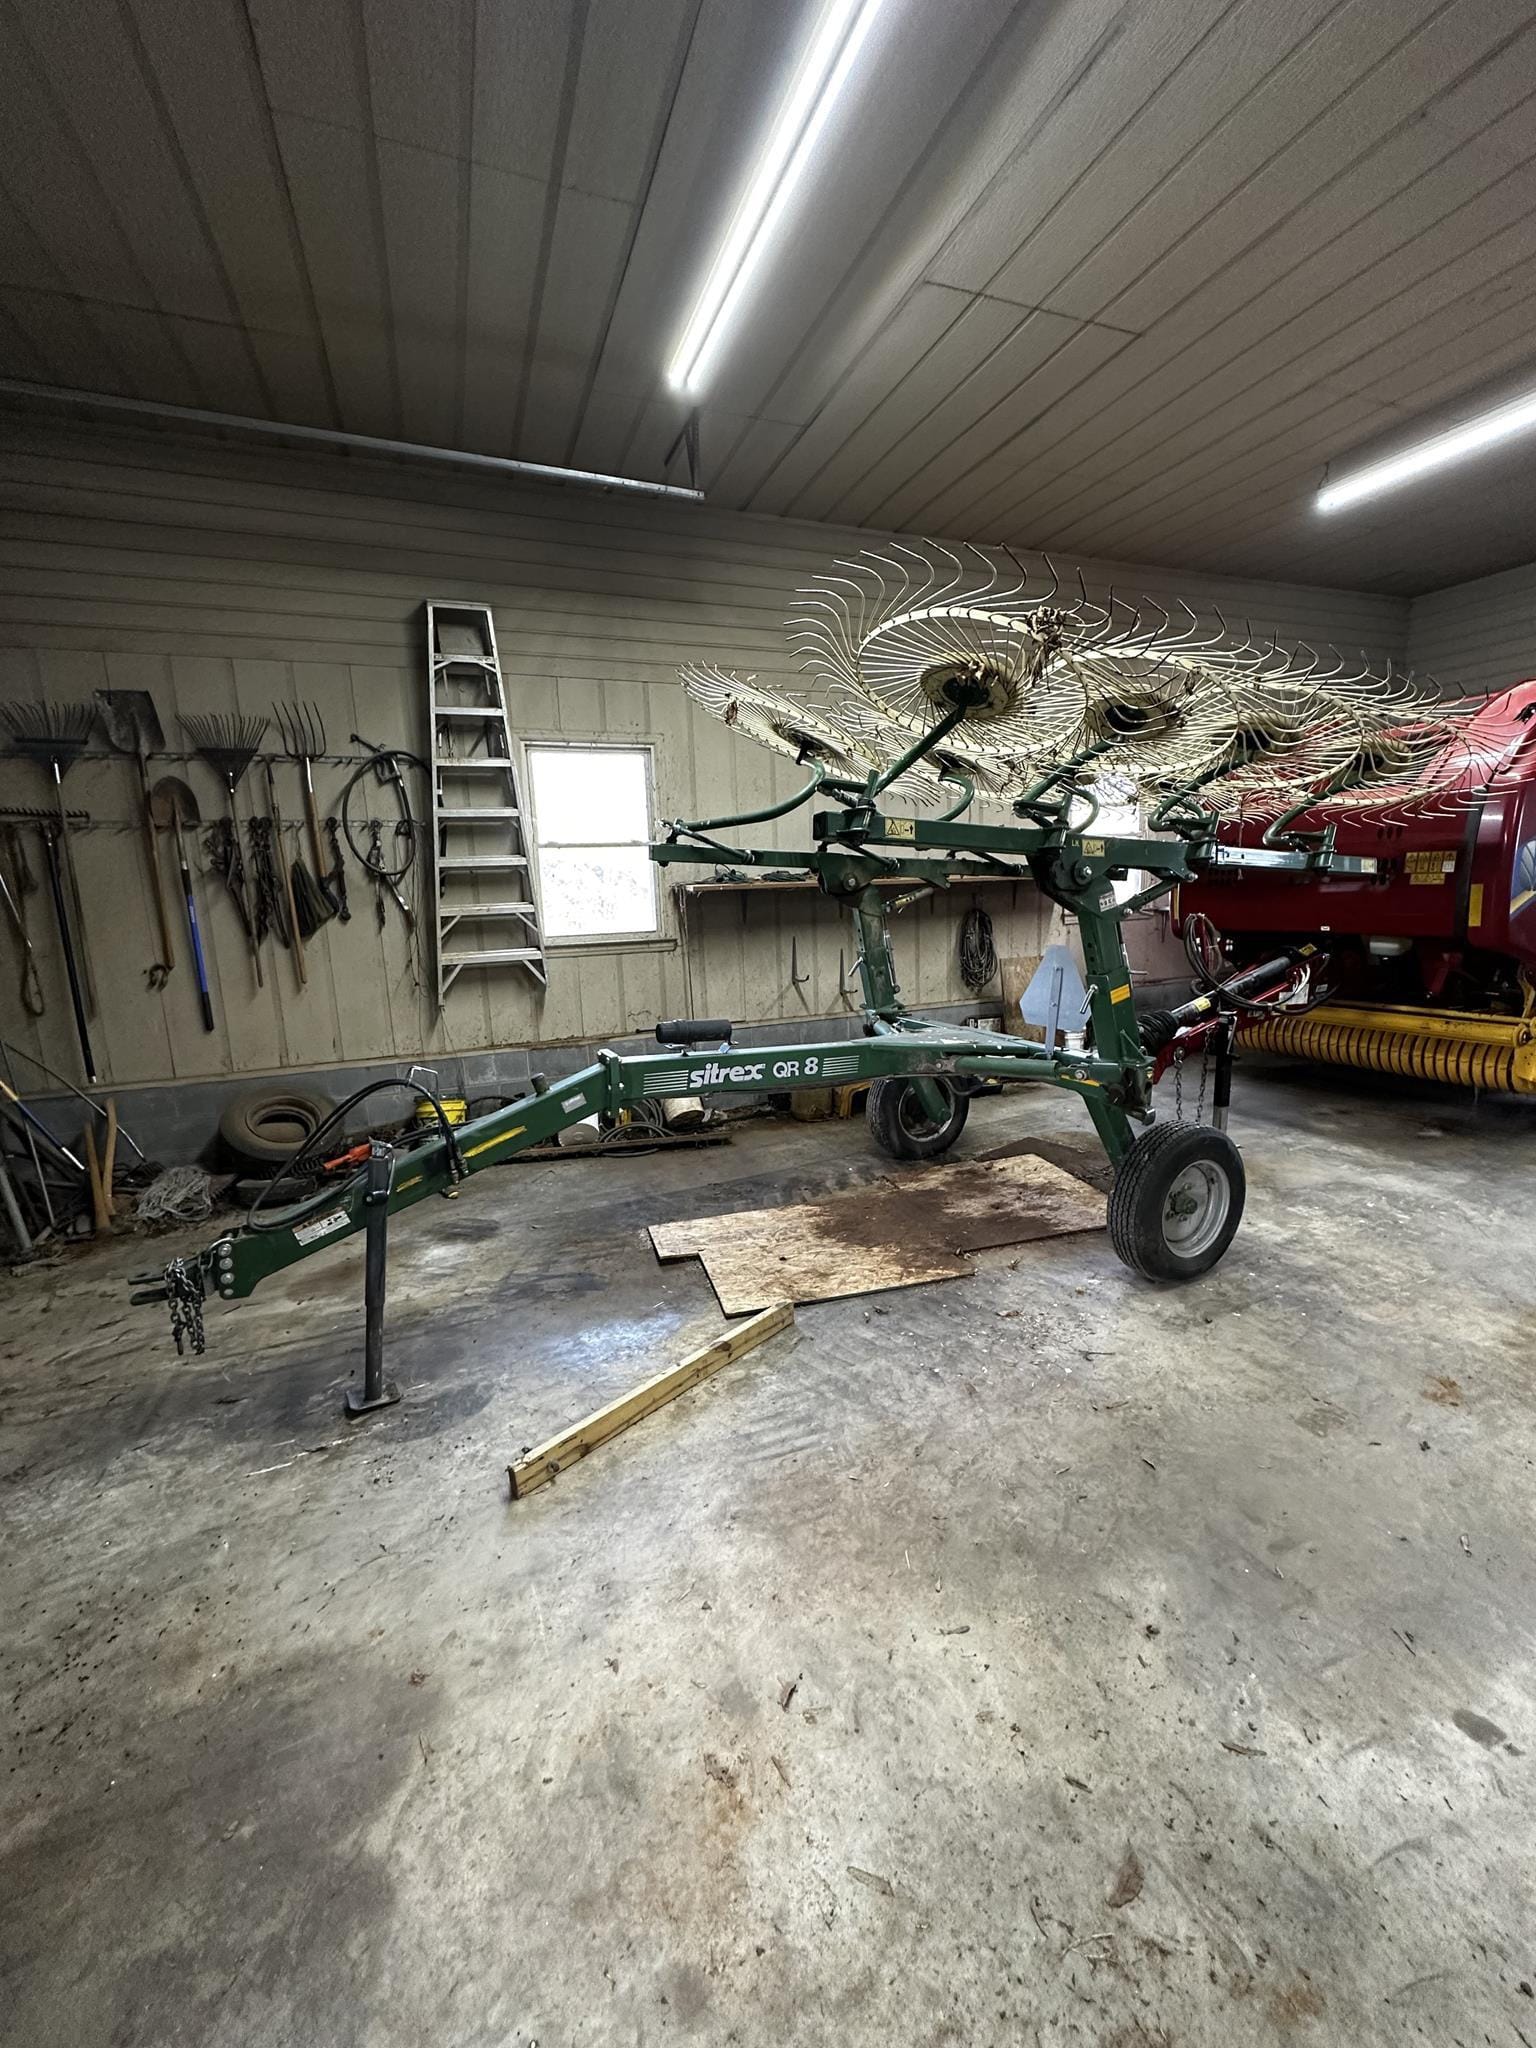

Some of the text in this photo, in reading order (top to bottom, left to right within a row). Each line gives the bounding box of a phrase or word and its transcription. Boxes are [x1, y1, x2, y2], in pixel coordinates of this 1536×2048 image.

[690, 1057, 819, 1088] sitrex QR 8
